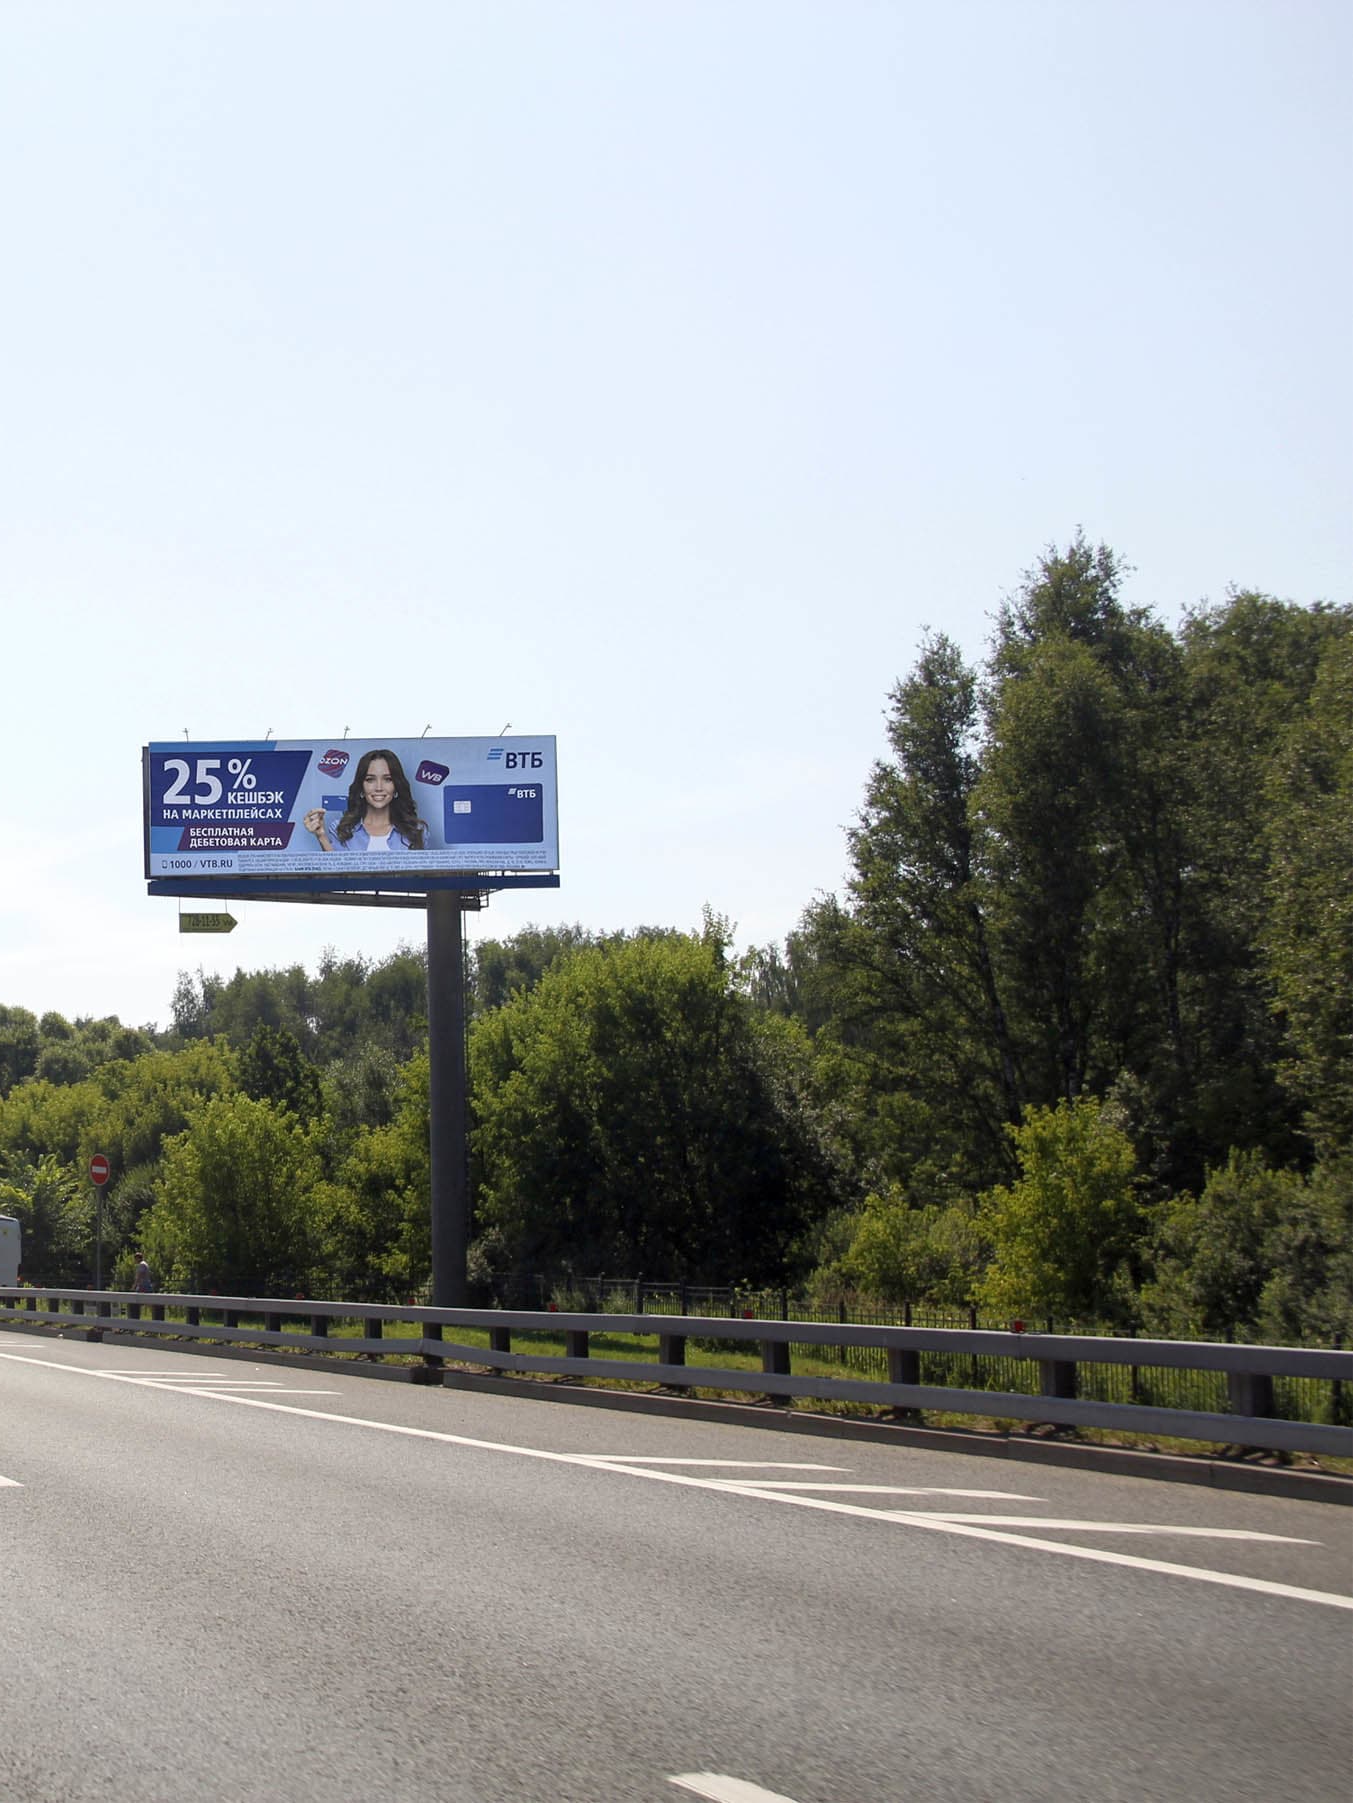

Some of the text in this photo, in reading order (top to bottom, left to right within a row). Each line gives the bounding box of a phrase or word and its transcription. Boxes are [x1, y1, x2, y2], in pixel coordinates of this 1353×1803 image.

[319, 757, 348, 766] OZON
[505, 752, 543, 769] ВТБ
[421, 769, 443, 783] WB
[227, 791, 284, 805] КЕШБЭК
[516, 788, 537, 799] ВТБ
[163, 808, 283, 820] НА МАРКЕТПЛЕЙСАХ
[189, 827, 254, 837] БЕСПЛАТНАЯ
[189, 836, 283, 849] ДЕБЕТОВАЯ КАРТА
[170, 860, 192, 869] 1000
[200, 859, 233, 869] VTB.RU
